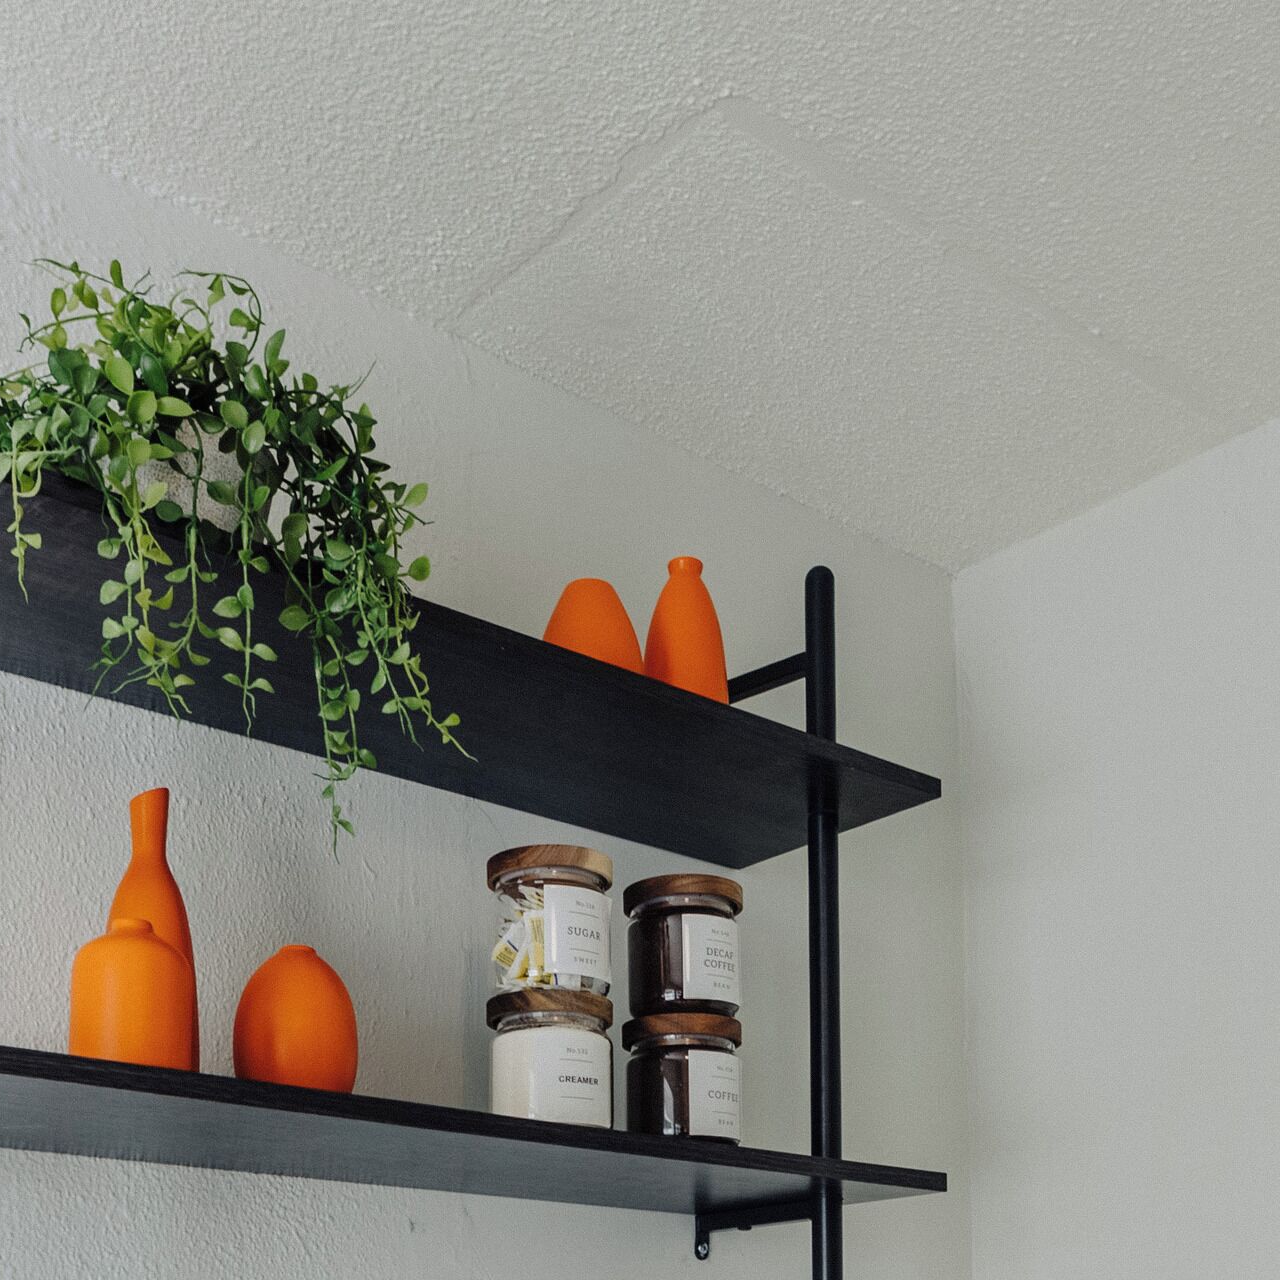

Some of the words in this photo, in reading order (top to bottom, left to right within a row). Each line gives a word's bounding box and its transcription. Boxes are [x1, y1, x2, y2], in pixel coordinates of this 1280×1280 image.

[567, 926, 601, 940] SUGAR
[706, 947, 734, 960] DECAF
[704, 959, 735, 973] COFFEE
[558, 1075, 599, 1086] CREAMER
